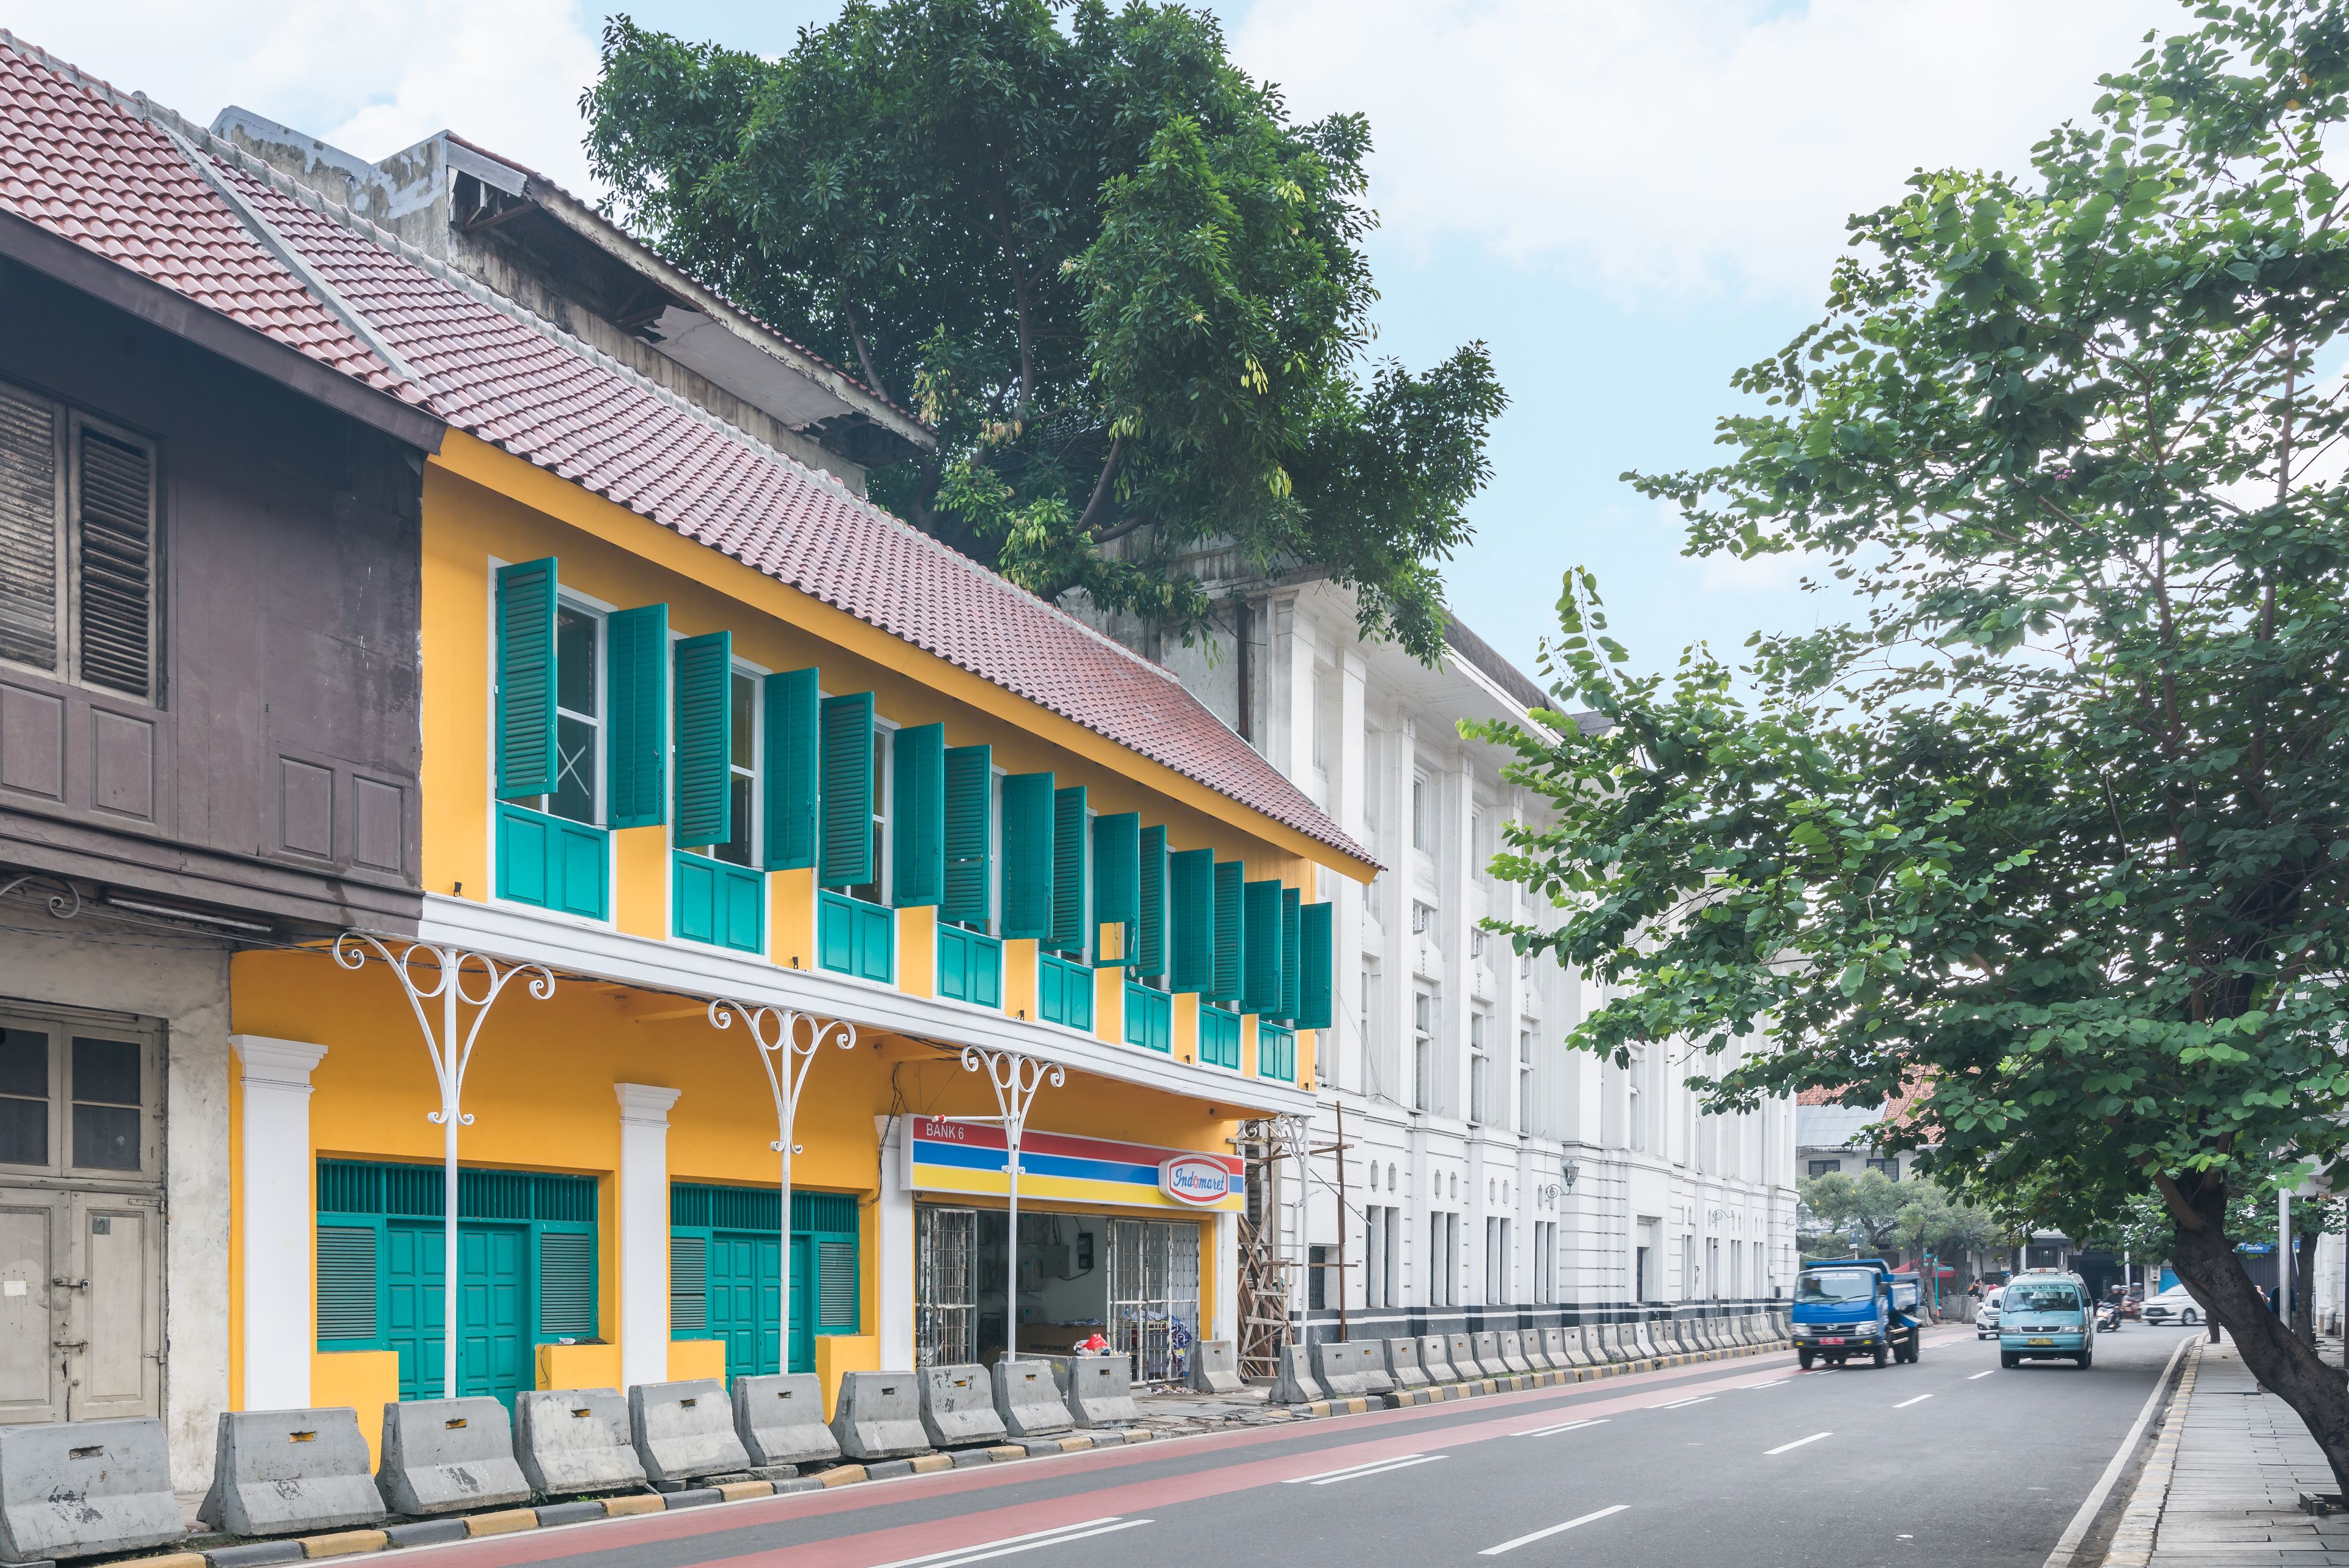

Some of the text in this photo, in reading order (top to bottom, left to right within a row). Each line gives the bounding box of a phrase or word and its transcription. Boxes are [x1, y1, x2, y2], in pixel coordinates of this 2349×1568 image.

[926, 1123, 964, 1140] BANK 6
[1173, 1167, 1225, 1191] Indomaret
